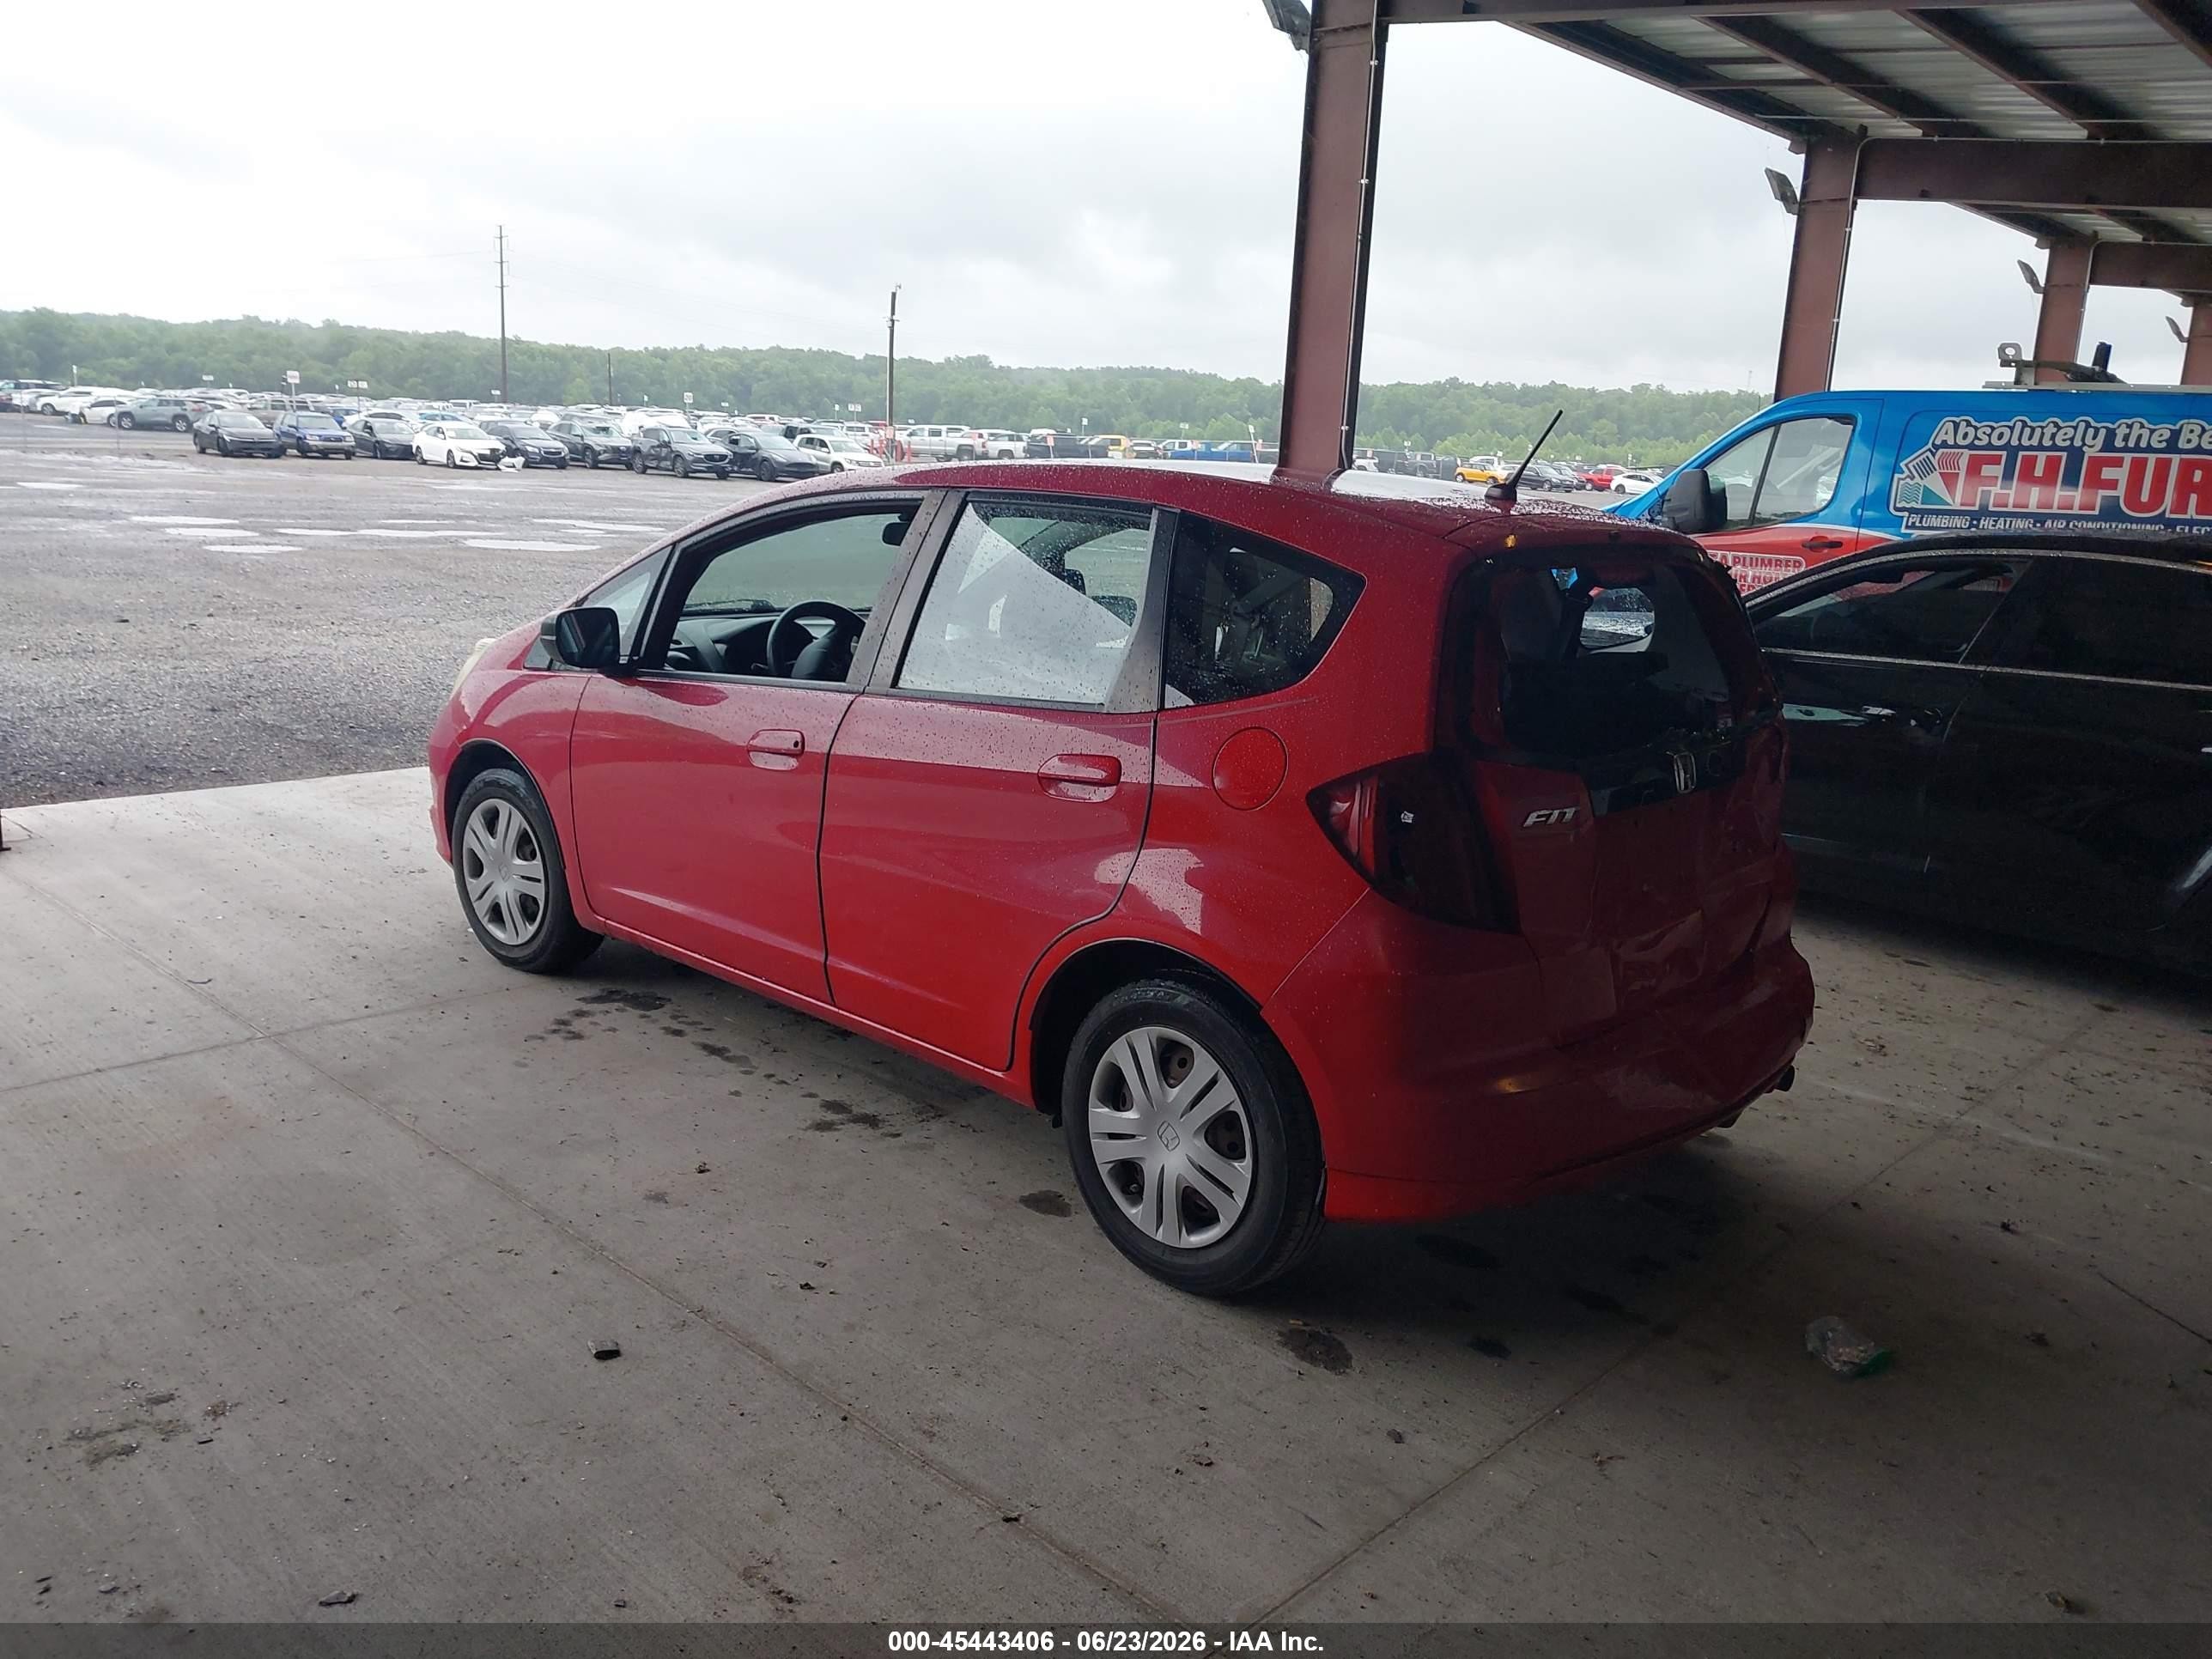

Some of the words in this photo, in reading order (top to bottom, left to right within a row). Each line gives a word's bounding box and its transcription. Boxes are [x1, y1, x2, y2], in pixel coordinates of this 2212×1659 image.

[1934, 421, 2106, 453] Absolutely
[2115, 422, 2169, 448] the
[1908, 514, 1971, 529] PLUMBING
[1978, 517, 2034, 529] HEATING
[1733, 556, 1802, 572] PLUMBER
[1523, 807, 1579, 827] FIT
